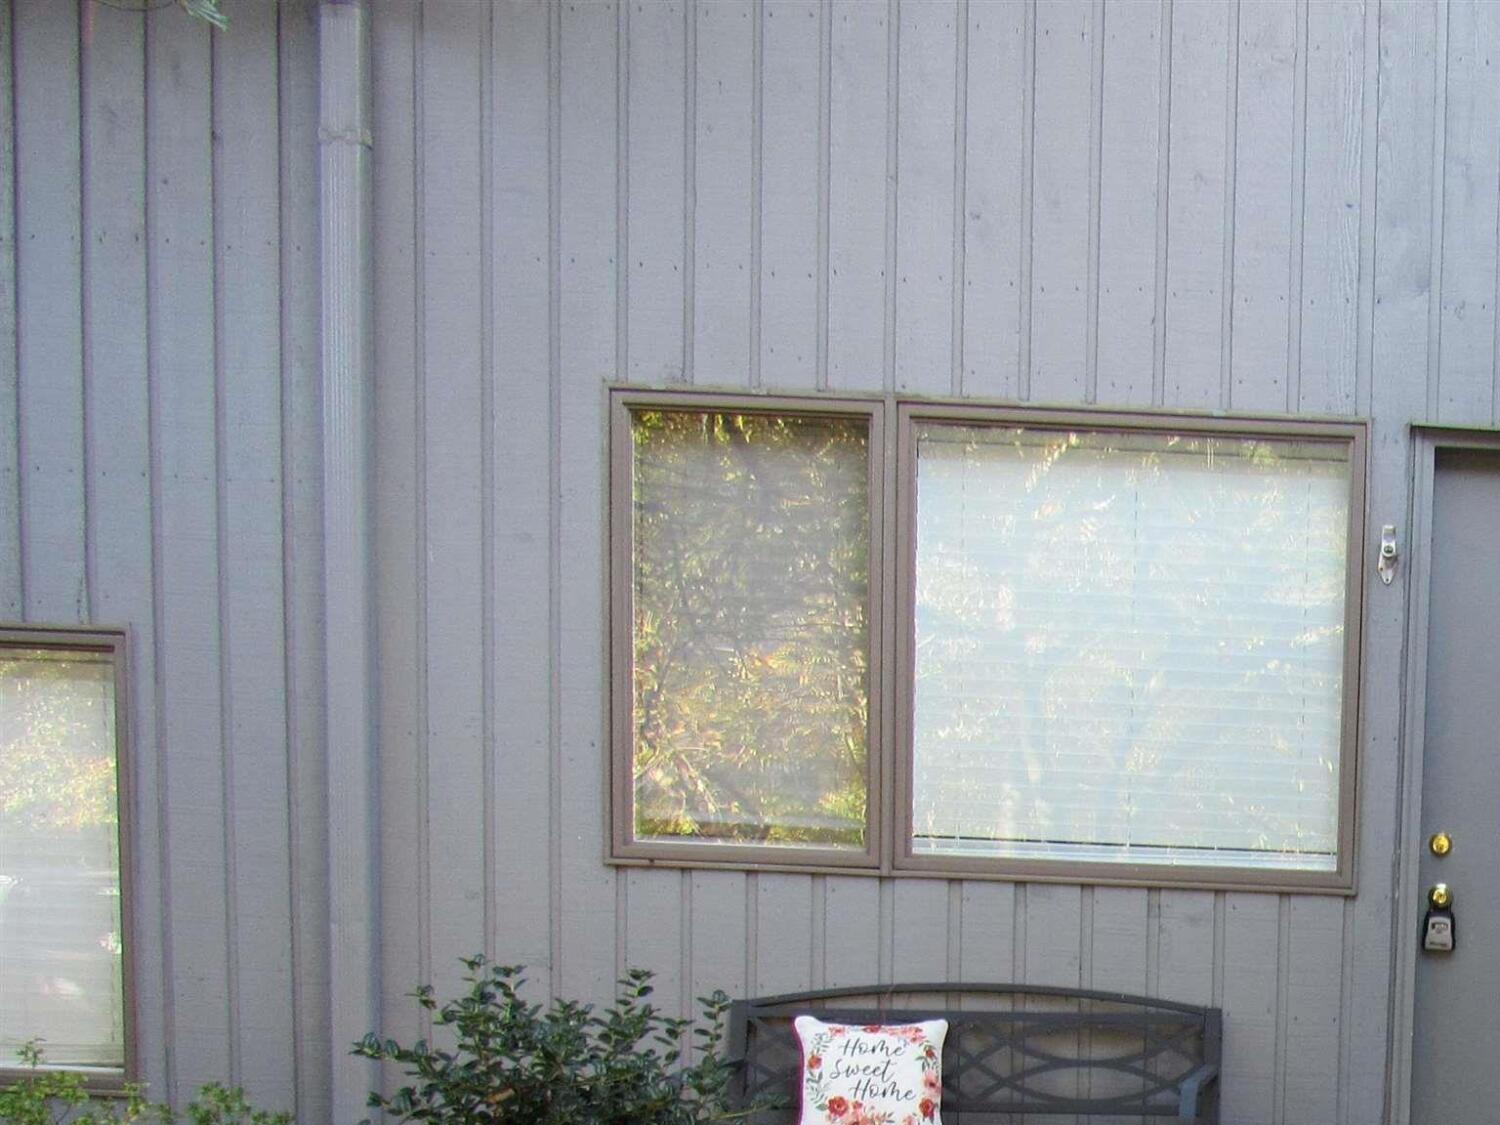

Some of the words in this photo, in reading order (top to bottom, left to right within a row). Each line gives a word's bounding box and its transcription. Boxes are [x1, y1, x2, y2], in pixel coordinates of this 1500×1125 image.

[838, 1037, 905, 1058] Home
[830, 1058, 896, 1083] Sweet
[849, 1077, 916, 1101] Home
